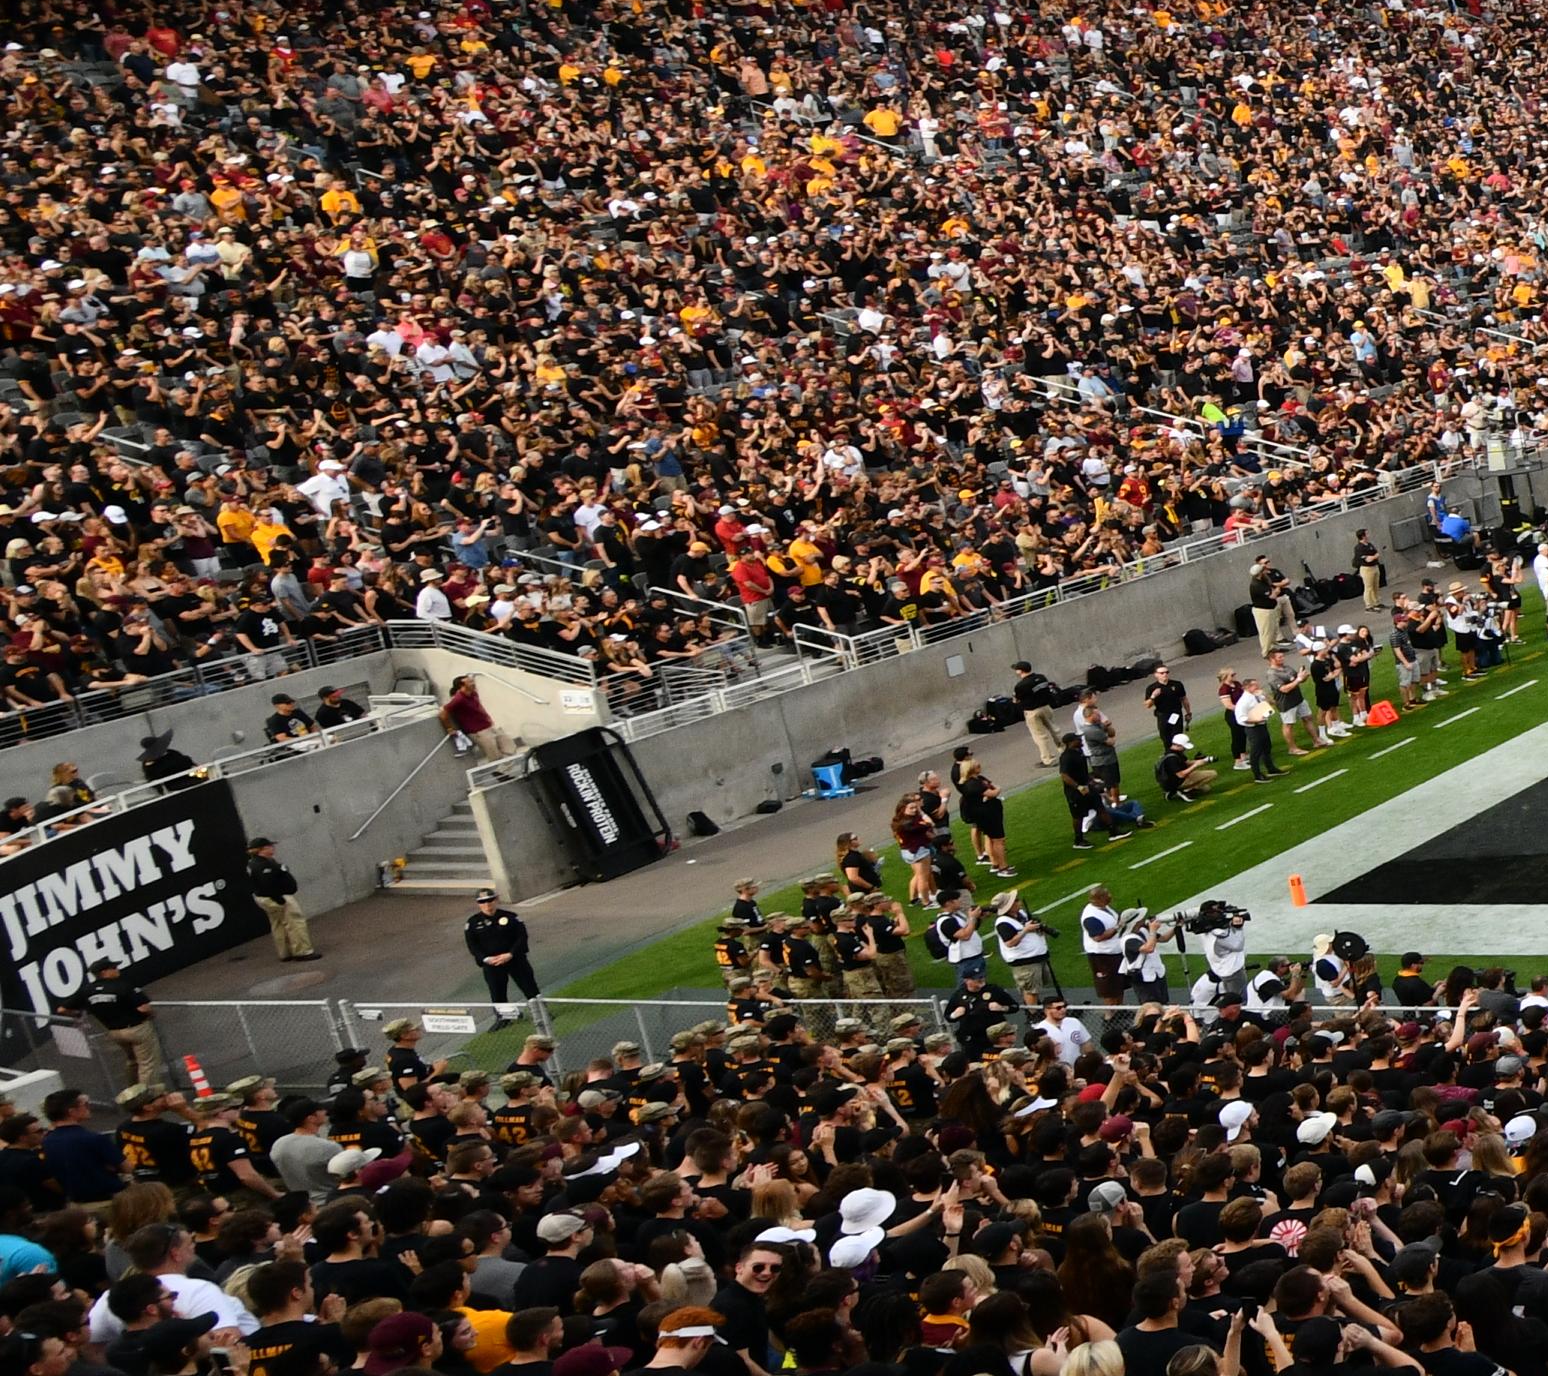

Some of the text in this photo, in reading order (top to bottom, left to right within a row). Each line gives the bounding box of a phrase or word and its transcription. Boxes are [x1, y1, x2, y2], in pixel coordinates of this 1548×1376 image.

[587, 798, 618, 845] PROTEIN
[0, 817, 197, 961] JIMMY
[498, 1126, 527, 1146] 42
